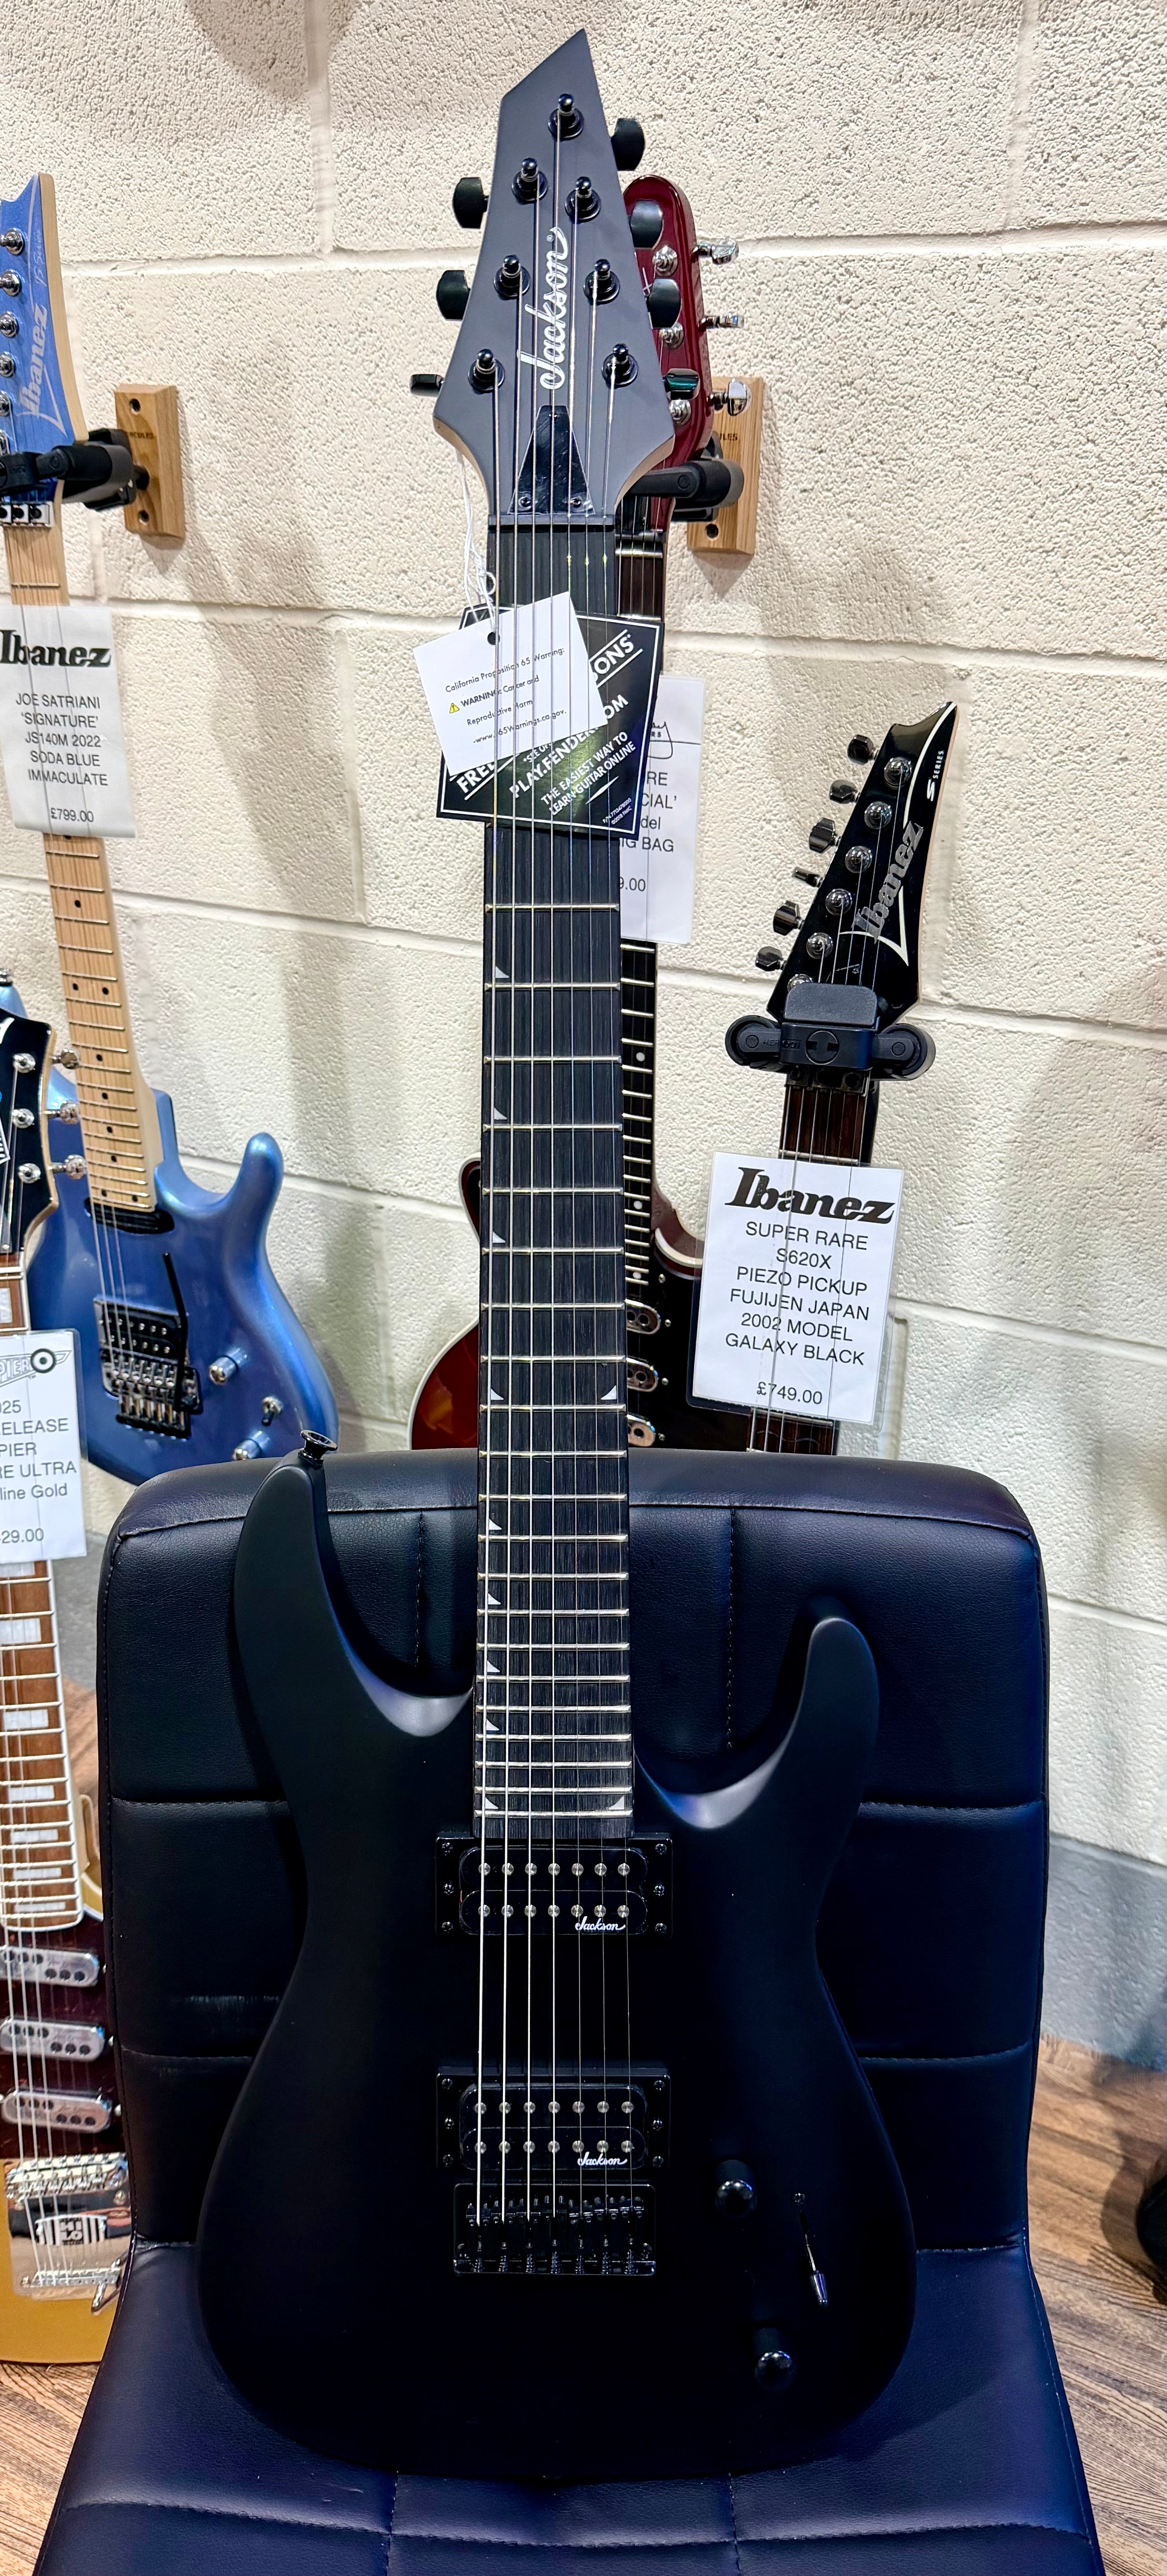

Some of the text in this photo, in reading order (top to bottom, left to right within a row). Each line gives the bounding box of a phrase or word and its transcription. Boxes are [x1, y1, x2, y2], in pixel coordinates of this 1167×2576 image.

[517, 227, 568, 390] Jackson
[18, 303, 48, 419] Ibanez
[0, 630, 112, 668] Ibanez
[446, 676, 480, 693] California
[521, 657, 530, 667] 65
[16, 693, 101, 709] JOE SATRIANI
[21, 712, 99, 728] 'SIGNATURE'
[473, 709, 567, 743] -www.65Warnings.ca.gov.
[25, 731, 102, 748] JS140M 2022
[30, 750, 101, 767] SODA BLUE
[540, 731, 628, 805] THE EASIEST WAY TO
[28, 769, 109, 787] IMMACULATE
[549, 741, 637, 815] LEARN GUITAR ONLINE
[647, 771, 668, 786] RE
[927, 750, 945, 801] S SERIES
[641, 793, 677, 810] CIAL'
[51, 808, 95, 823] £799.00
[641, 815, 661, 830] del
[641, 837, 674, 852] BAG
[851, 820, 924, 945] Ibanez
[724, 1166, 896, 1224] Ibanez
[745, 1221, 868, 1251] SUPER RARE
[775, 1248, 832, 1270] S620X
[736, 1266, 867, 1297] PIEZO PICKUP
[730, 1288, 869, 1321] FUJIJEN JAPAN
[741, 1312, 853, 1342] 2002 MODEL
[725, 1334, 865, 1366] GALAXY BLACK
[756, 1382, 823, 1405] £749.00
[0, 1417, 69, 1436] ELEASE
[0, 1442, 37, 1457] PIER
[20, 1460, 77, 1478] ULTRA
[31, 1482, 68, 1499] Gold
[0, 1527, 44, 1544] 29.00
[575, 1916, 626, 1931] Jackson
[577, 2151, 627, 2166] Jackson
